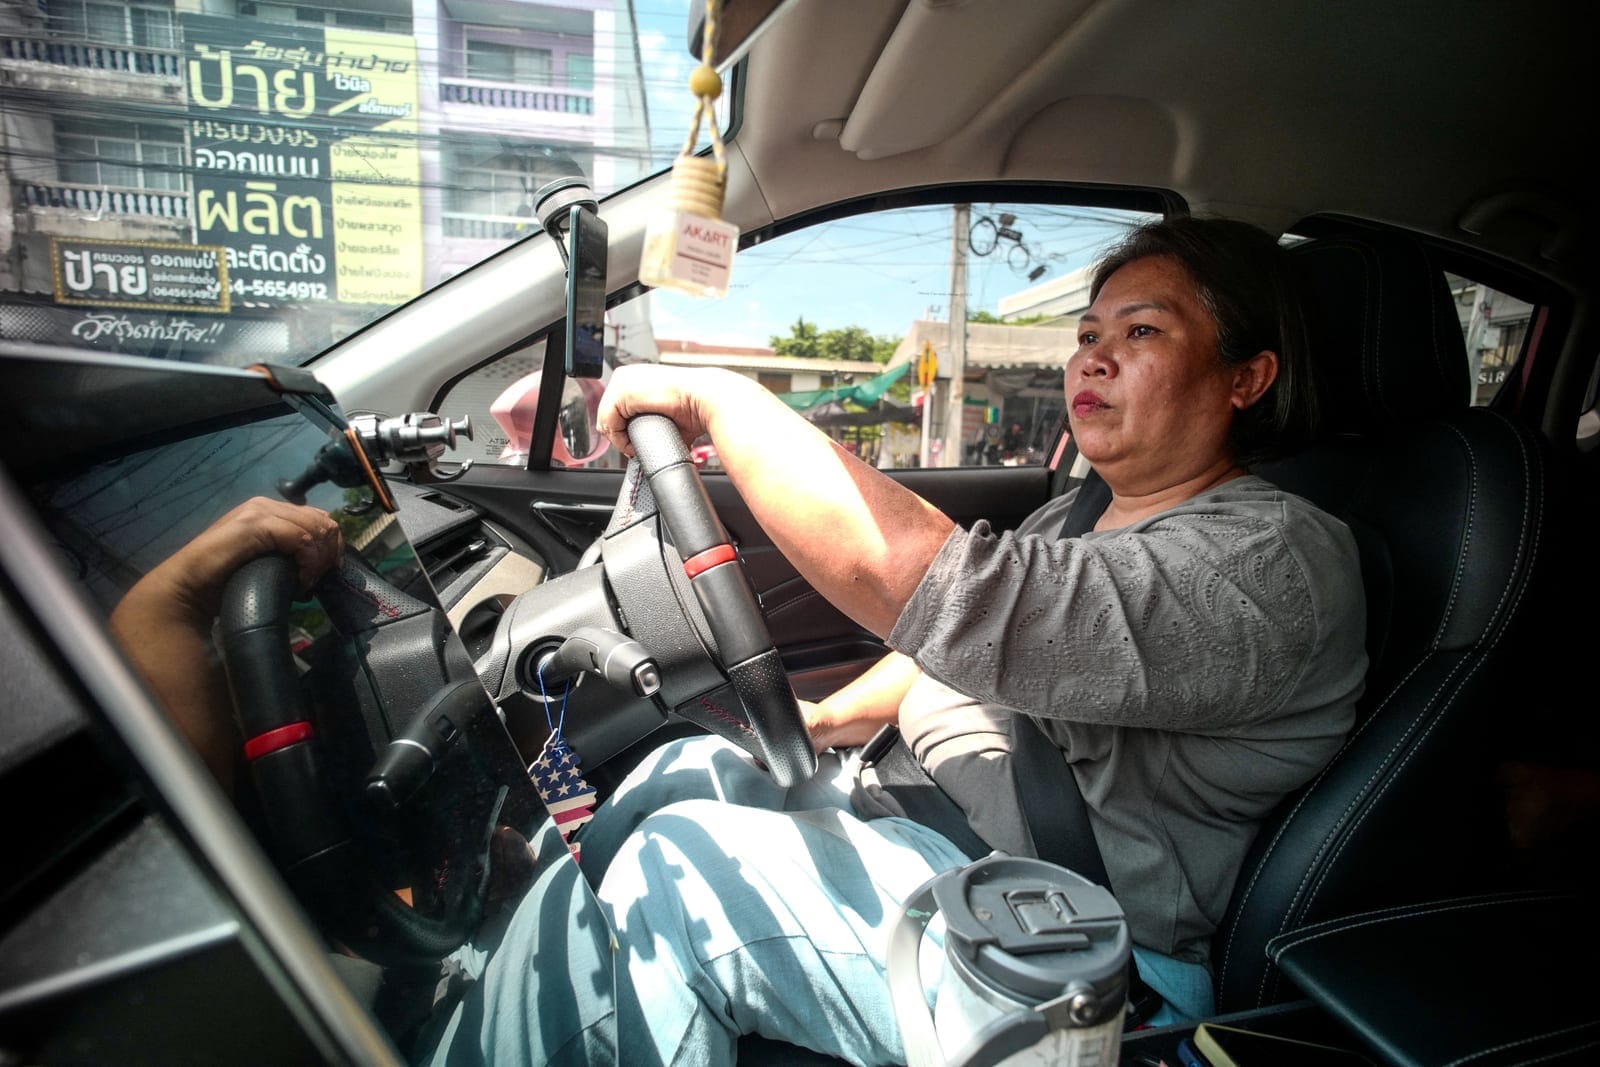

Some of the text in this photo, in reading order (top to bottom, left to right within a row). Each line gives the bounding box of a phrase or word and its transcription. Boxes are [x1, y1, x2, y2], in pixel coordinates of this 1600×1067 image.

[189, 43, 316, 119] ป้าย
[335, 74, 371, 92] ไวนิล
[195, 149, 320, 178] ออกแบบ
[198, 182, 324, 240] ผลิต
[64, 250, 148, 296] ป้าย
[150, 254, 214, 269] ออกแบบ
[204, 243, 327, 275] ละติดตั้ง
[208, 278, 328, 299] 4-5654912
